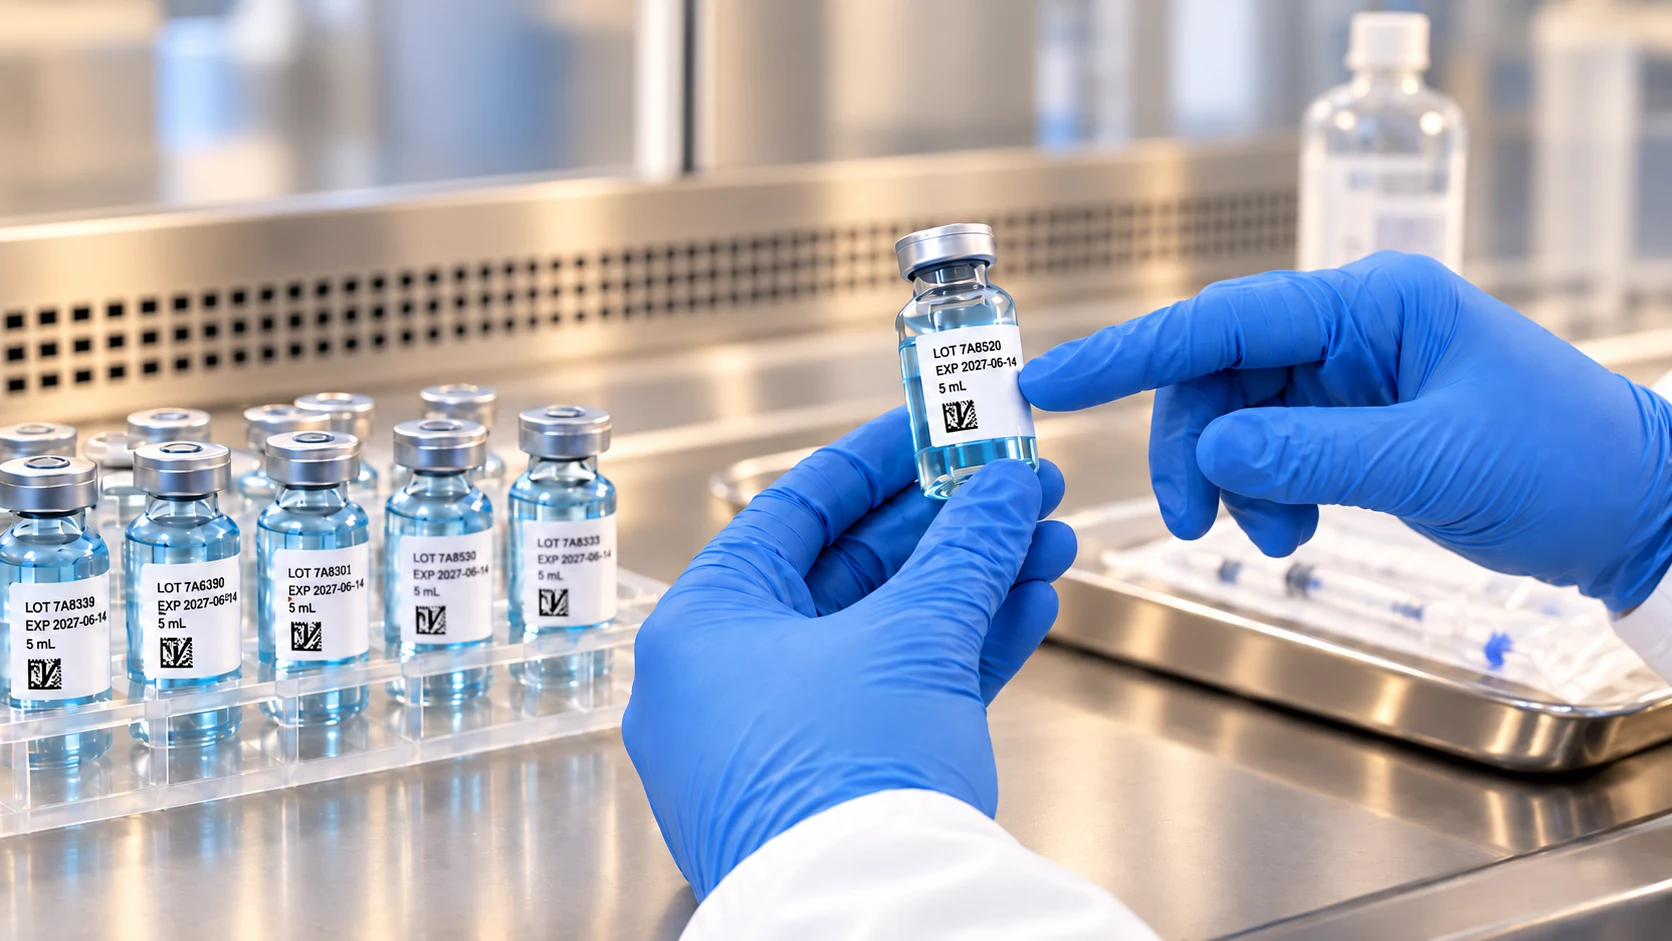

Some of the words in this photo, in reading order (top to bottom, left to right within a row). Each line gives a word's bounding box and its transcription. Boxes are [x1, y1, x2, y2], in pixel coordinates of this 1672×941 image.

[933, 345, 957, 358] LOT
[960, 340, 1001, 354] 7A8520
[936, 363, 958, 376] EXP
[961, 357, 1017, 372] 2027-06-14
[939, 383, 946, 394] 5
[949, 381, 967, 392] mL
[537, 538, 560, 548] LOT
[413, 553, 436, 563] LOT
[439, 551, 476, 563] 7A8530
[538, 554, 559, 564] EXP
[562, 549, 611, 564] 2027-06-14
[288, 568, 311, 578] LOT
[314, 564, 351, 577] 7A8301
[413, 569, 435, 580] EXP
[438, 565, 488, 580] 2027-06-14
[538, 571, 544, 581] 5
[547, 571, 564, 581] mL
[157, 583, 182, 593] LOT
[185, 577, 224, 592] 7A6390
[289, 585, 310, 595] EXP
[313, 578, 364, 596] 2027-06-14
[414, 586, 420, 597] 5
[423, 587, 440, 598] mL
[25, 602, 50, 613] LOT
[54, 596, 95, 612] 7A8339
[158, 600, 181, 611] EXP
[289, 603, 295, 614] 5
[299, 603, 316, 614] mL
[26, 620, 50, 631] EXP
[53, 611, 107, 630] 2027-06-14
[158, 618, 165, 630] 5
[168, 618, 186, 630] mL
[26, 639, 33, 650] 5
[37, 639, 55, 650] mL
